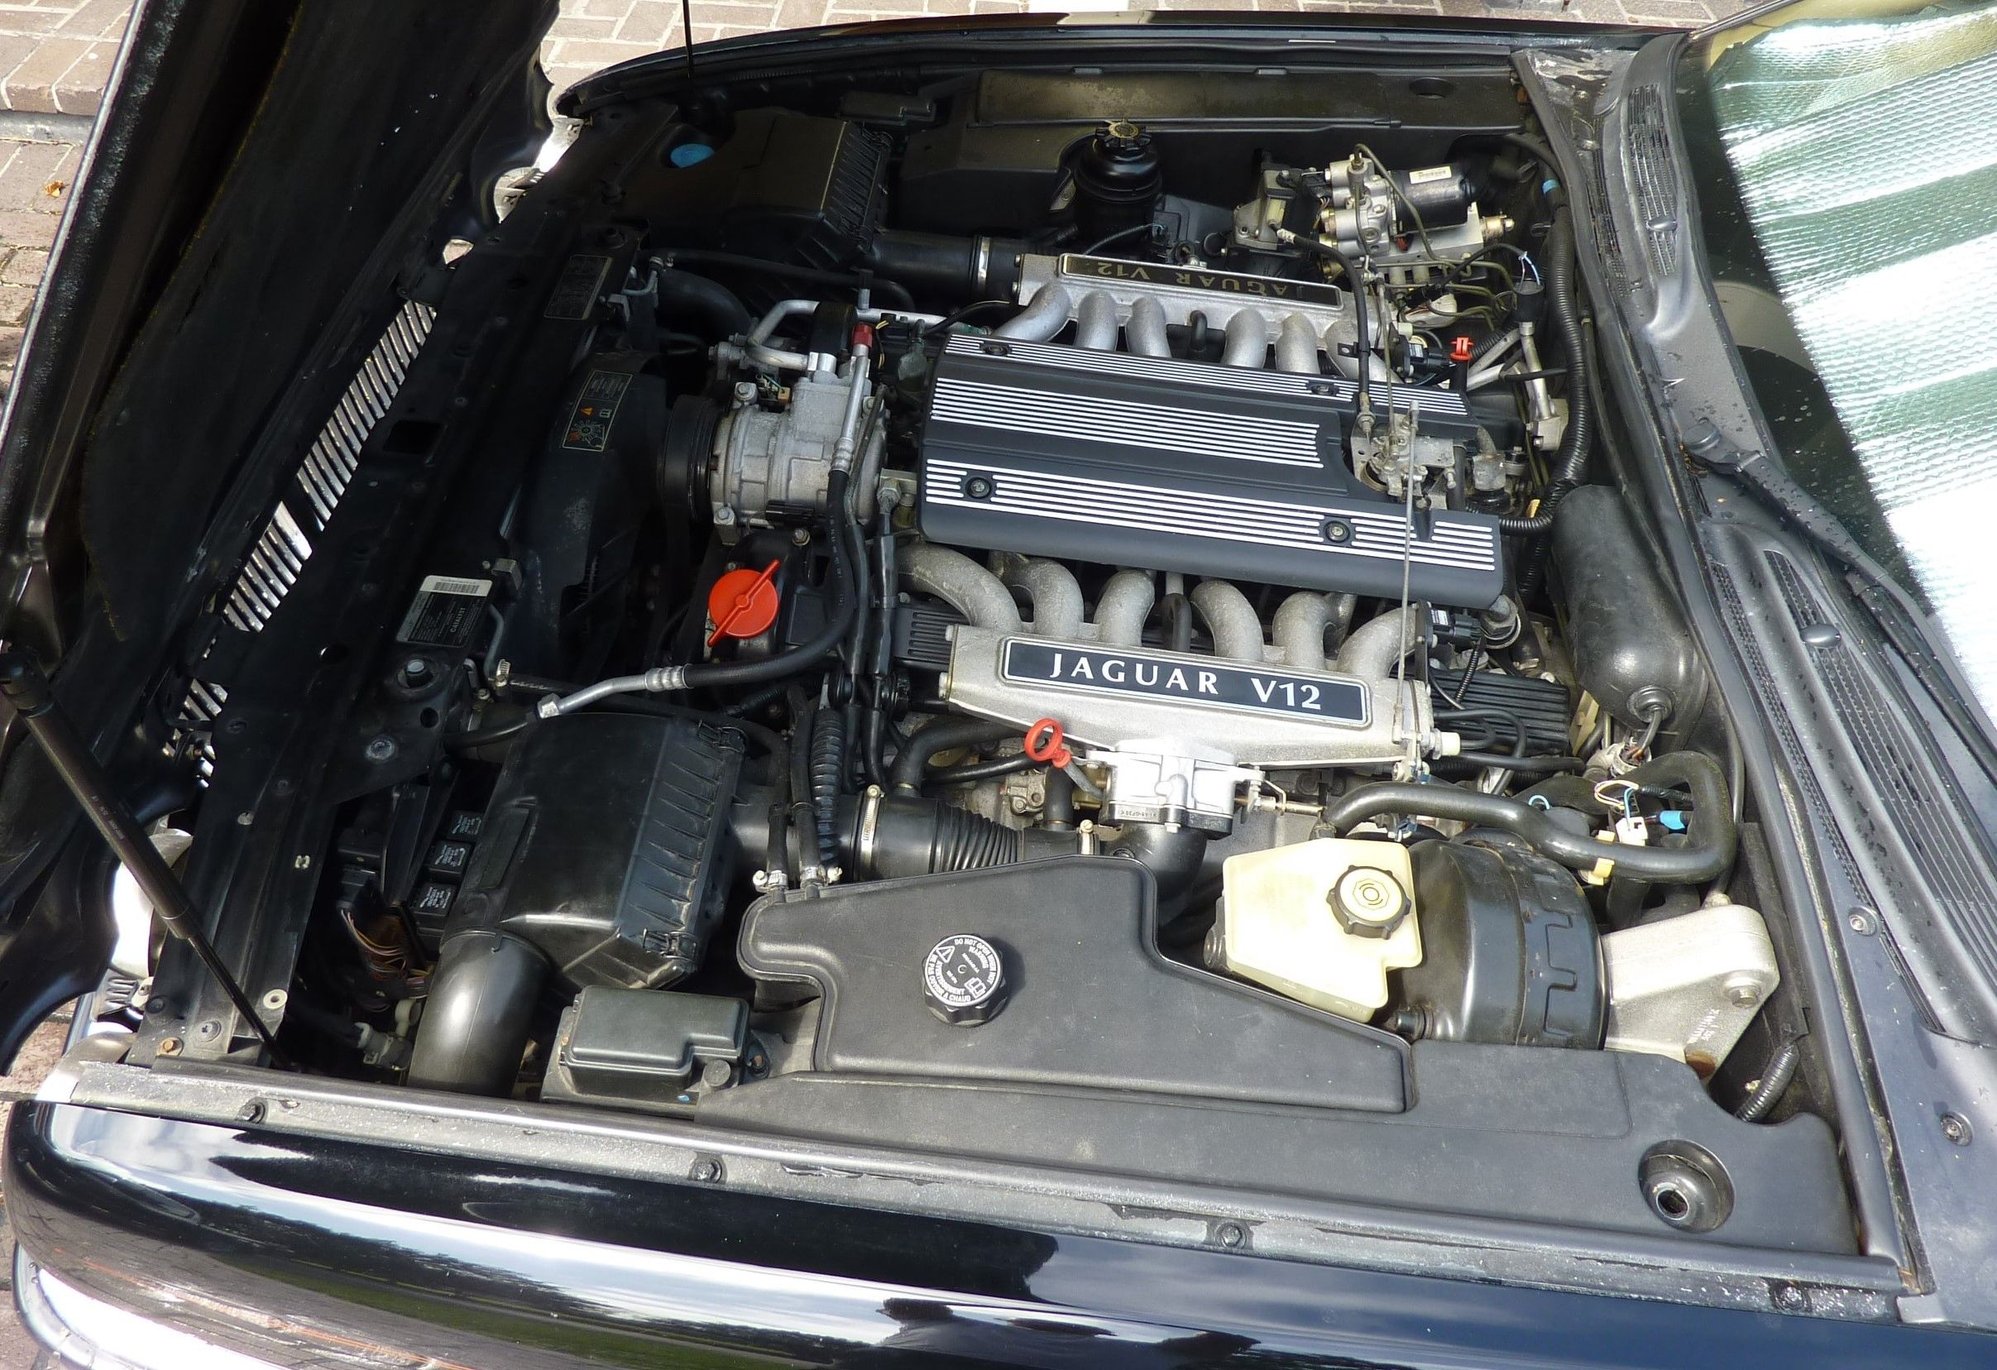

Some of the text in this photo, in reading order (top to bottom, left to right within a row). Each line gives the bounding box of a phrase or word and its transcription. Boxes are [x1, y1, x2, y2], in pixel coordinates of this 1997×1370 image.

[1097, 261, 1151, 280] V12
[1049, 653, 1321, 711] JAGUAR V12
[954, 938, 964, 946] DO
[964, 939, 978, 947] NOT
[976, 942, 991, 956] OPEN
[968, 946, 989, 969] WARNING
